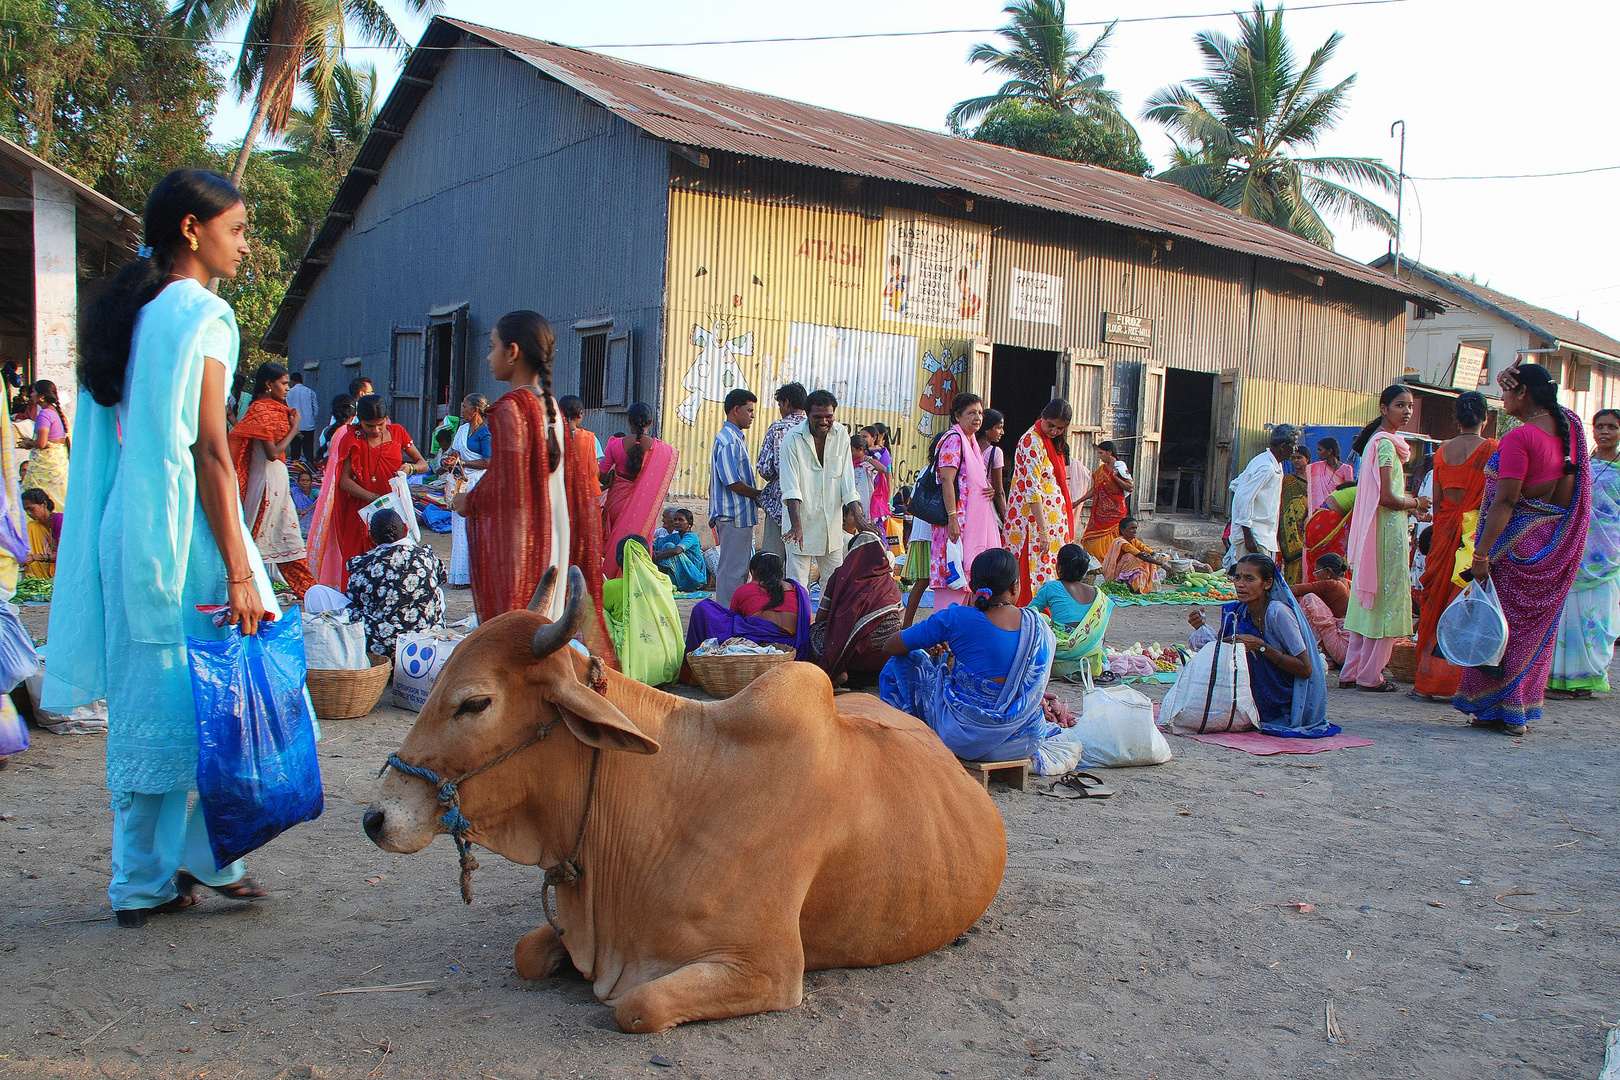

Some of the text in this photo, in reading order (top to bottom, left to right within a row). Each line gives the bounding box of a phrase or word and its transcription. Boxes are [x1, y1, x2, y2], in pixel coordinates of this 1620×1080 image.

[794, 237, 862, 268] ATASH
[1116, 314, 1142, 328] FIROZ
[1106, 323, 1123, 334] FLOUR
